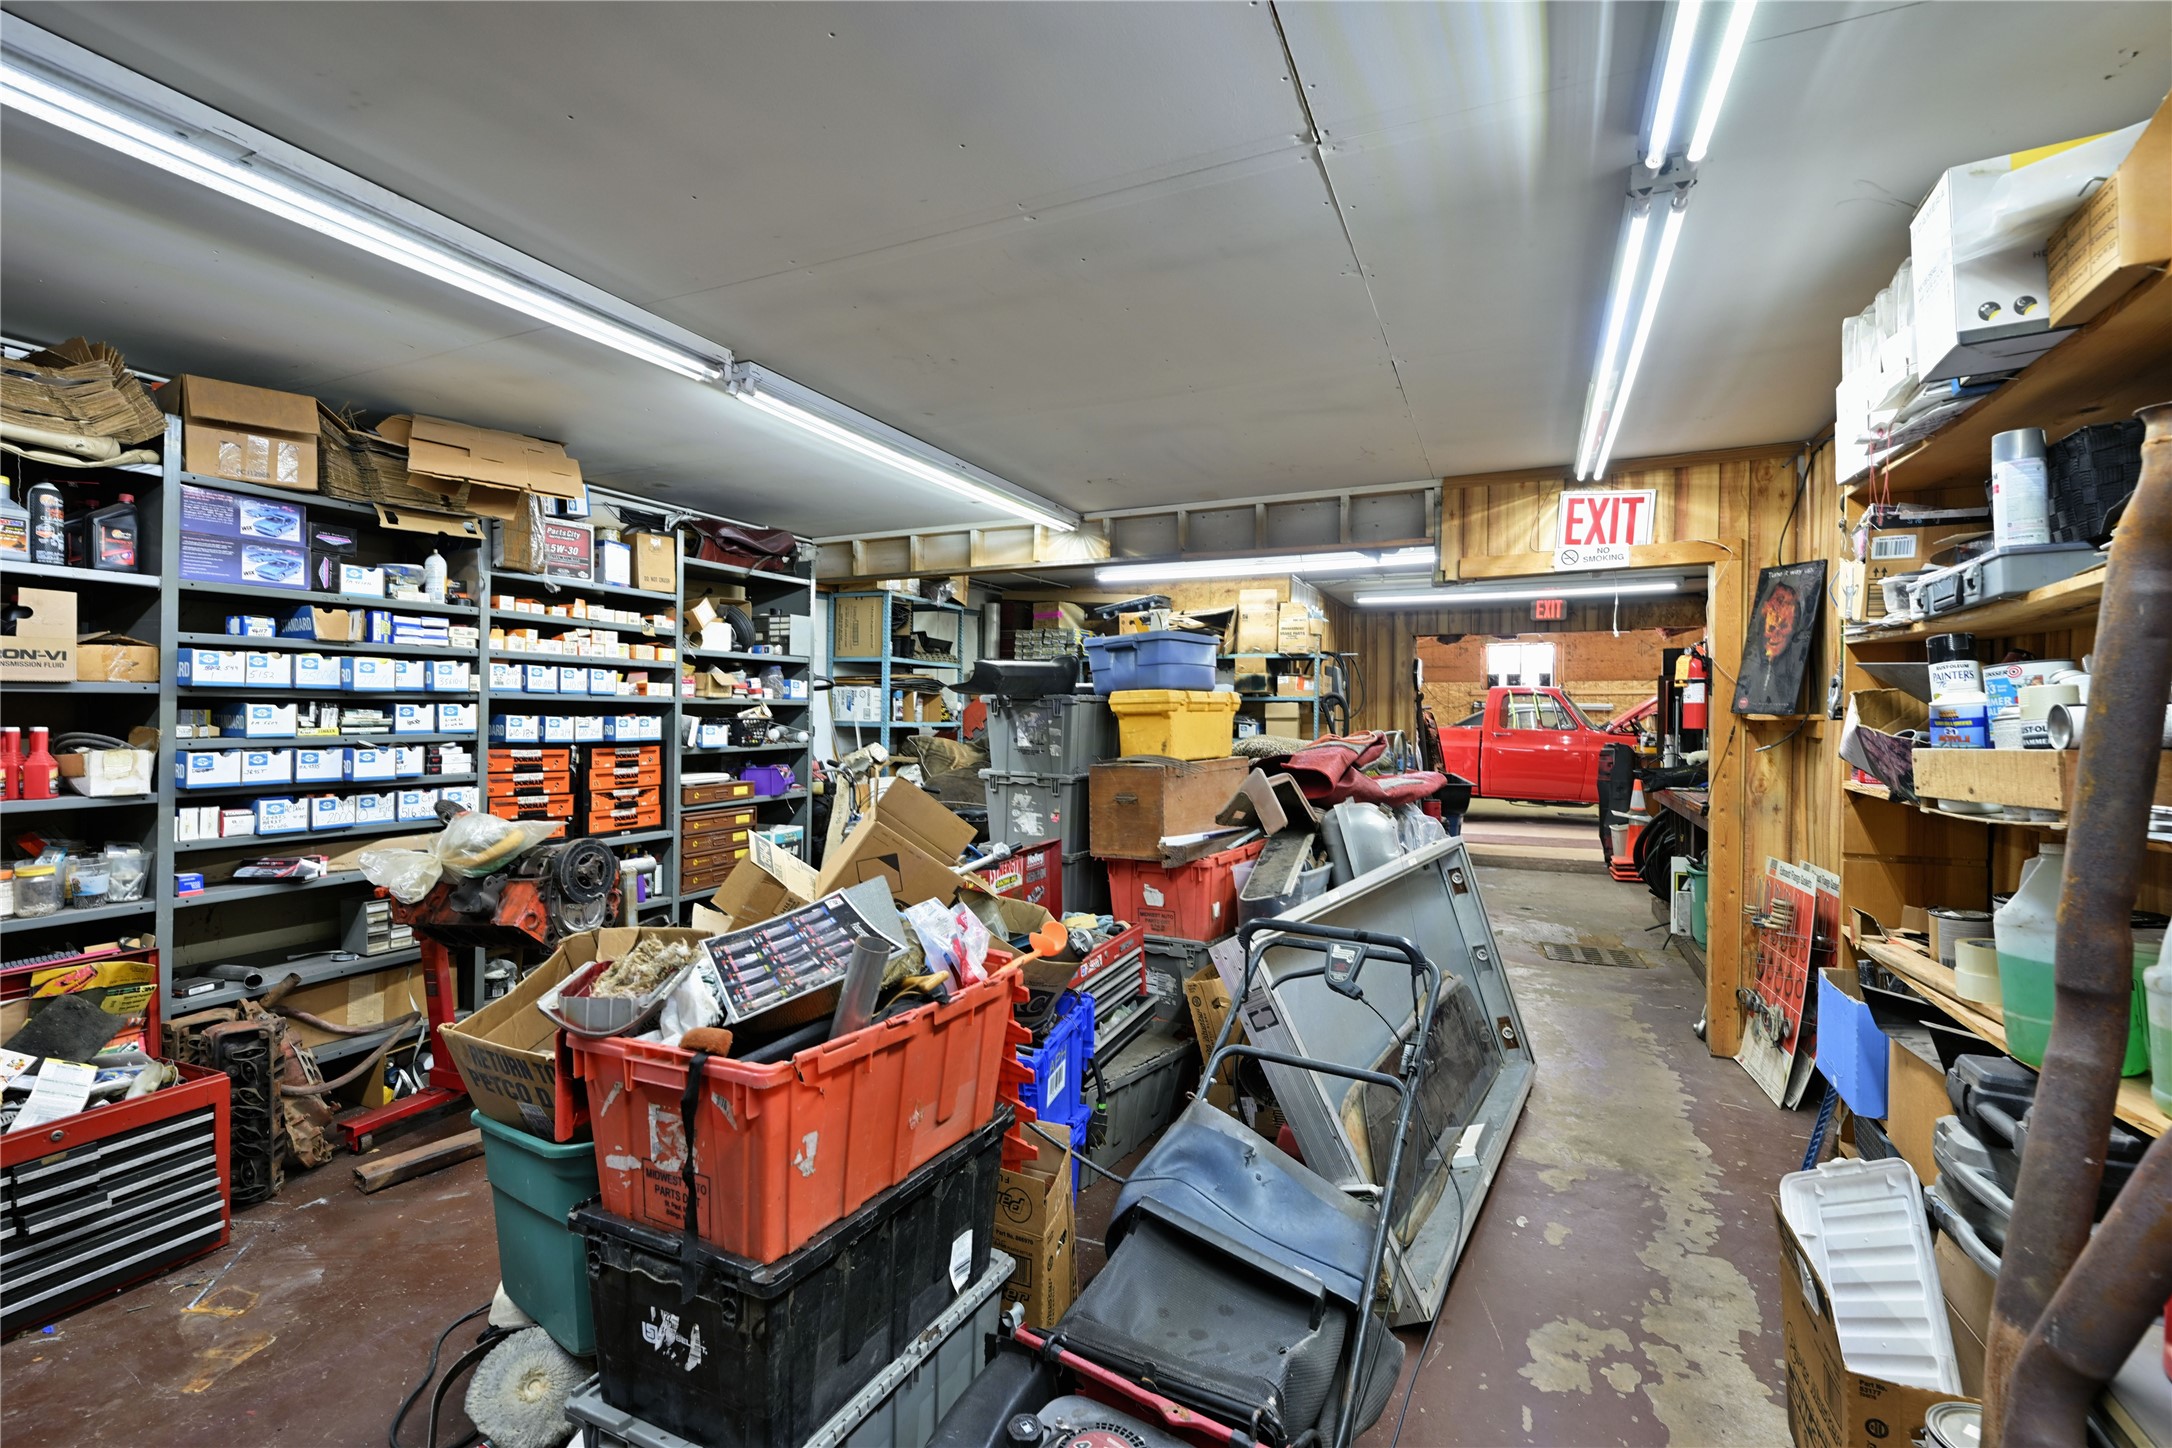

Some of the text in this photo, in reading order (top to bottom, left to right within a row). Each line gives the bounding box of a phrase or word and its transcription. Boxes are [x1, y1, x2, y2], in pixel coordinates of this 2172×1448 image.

[1565, 497, 1645, 545] EXIT
[550, 544, 579, 556] 5W-30
[1583, 554, 1624, 563] SMOKING
[1536, 599, 1563, 619] EXIT
[281, 617, 312, 632] STANDARD
[468, 1044, 535, 1082] RETURN
[532, 1062, 555, 1086] TO
[466, 1067, 532, 1104] PETCO
[646, 1168, 682, 1186] MIDWEST
[655, 1184, 680, 1202] PARTS
